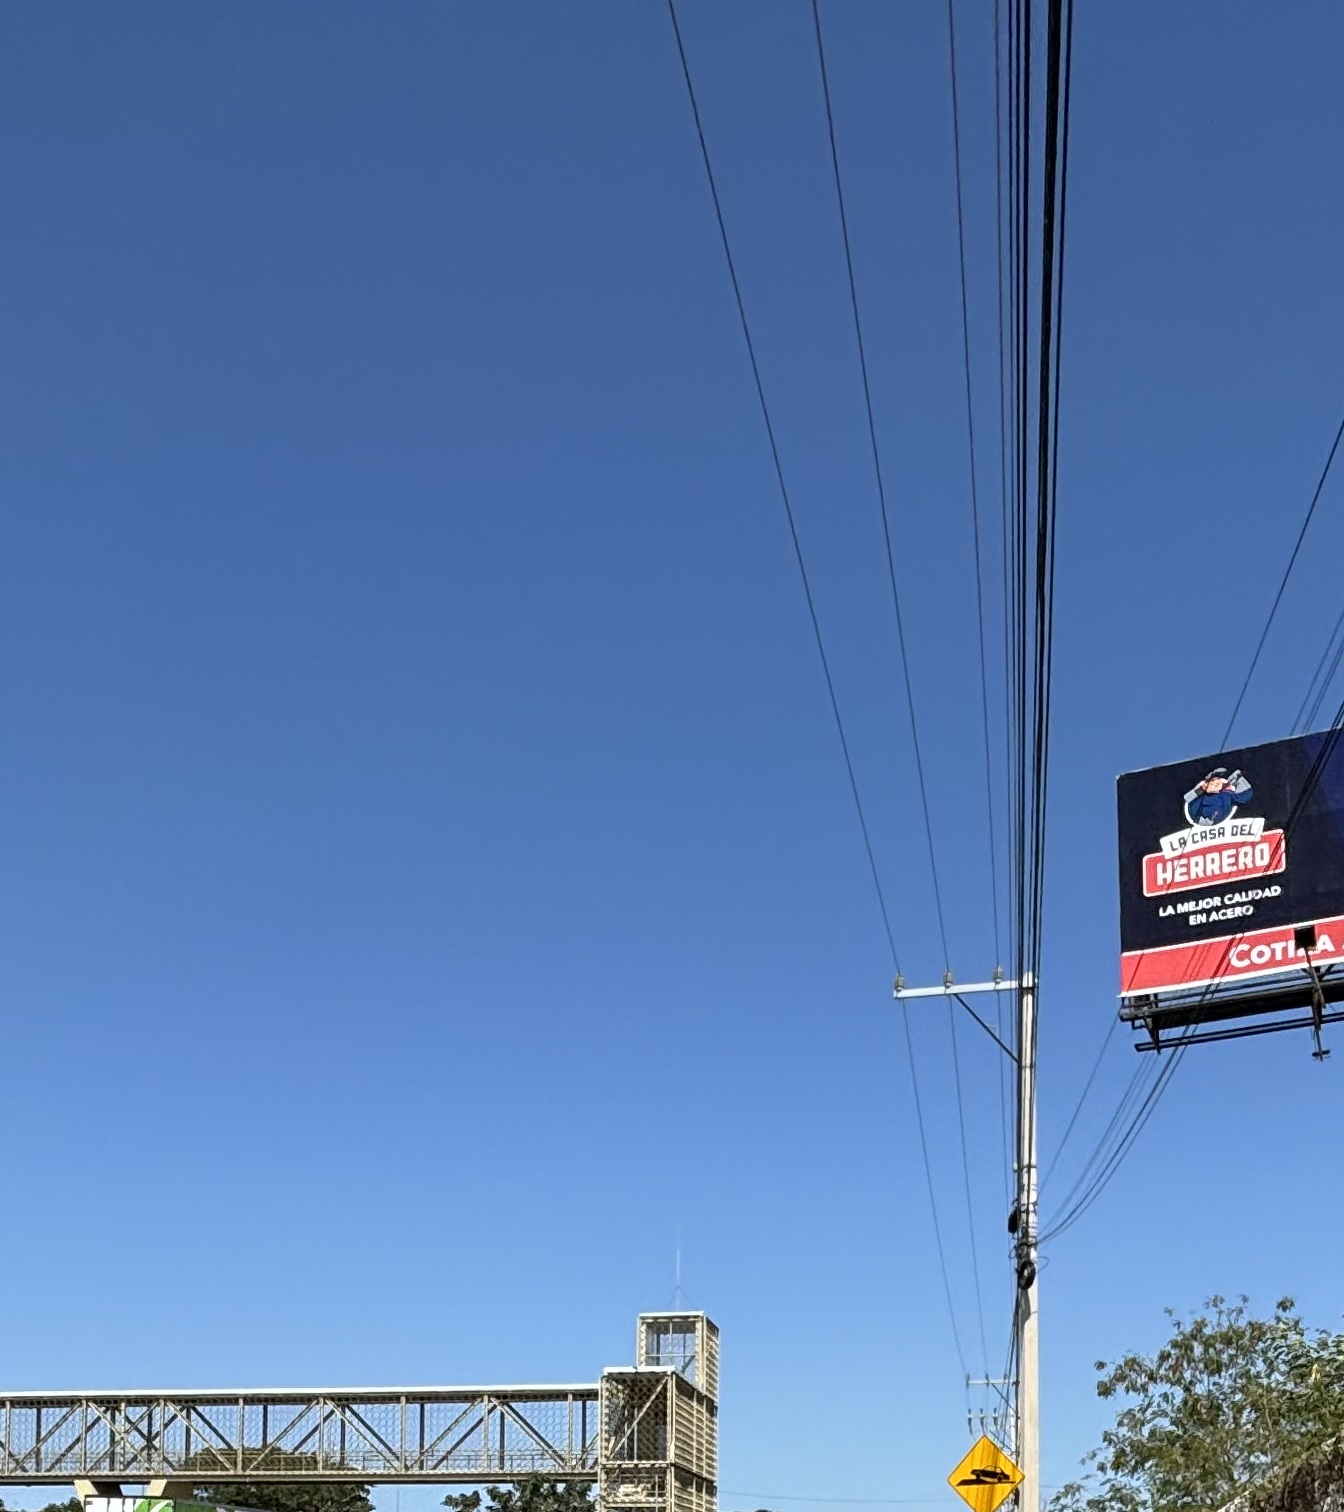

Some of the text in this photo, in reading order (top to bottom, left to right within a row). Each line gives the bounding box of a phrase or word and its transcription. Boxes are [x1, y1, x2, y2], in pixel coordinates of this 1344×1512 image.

[1169, 824, 1256, 851] LA CASA DEL
[1156, 842, 1271, 886] HERRERO
[1159, 885, 1282, 917] LA MEJOR CALIDAD
[1189, 905, 1254, 926] EN ACERO
[1229, 934, 1335, 968] COTIA
